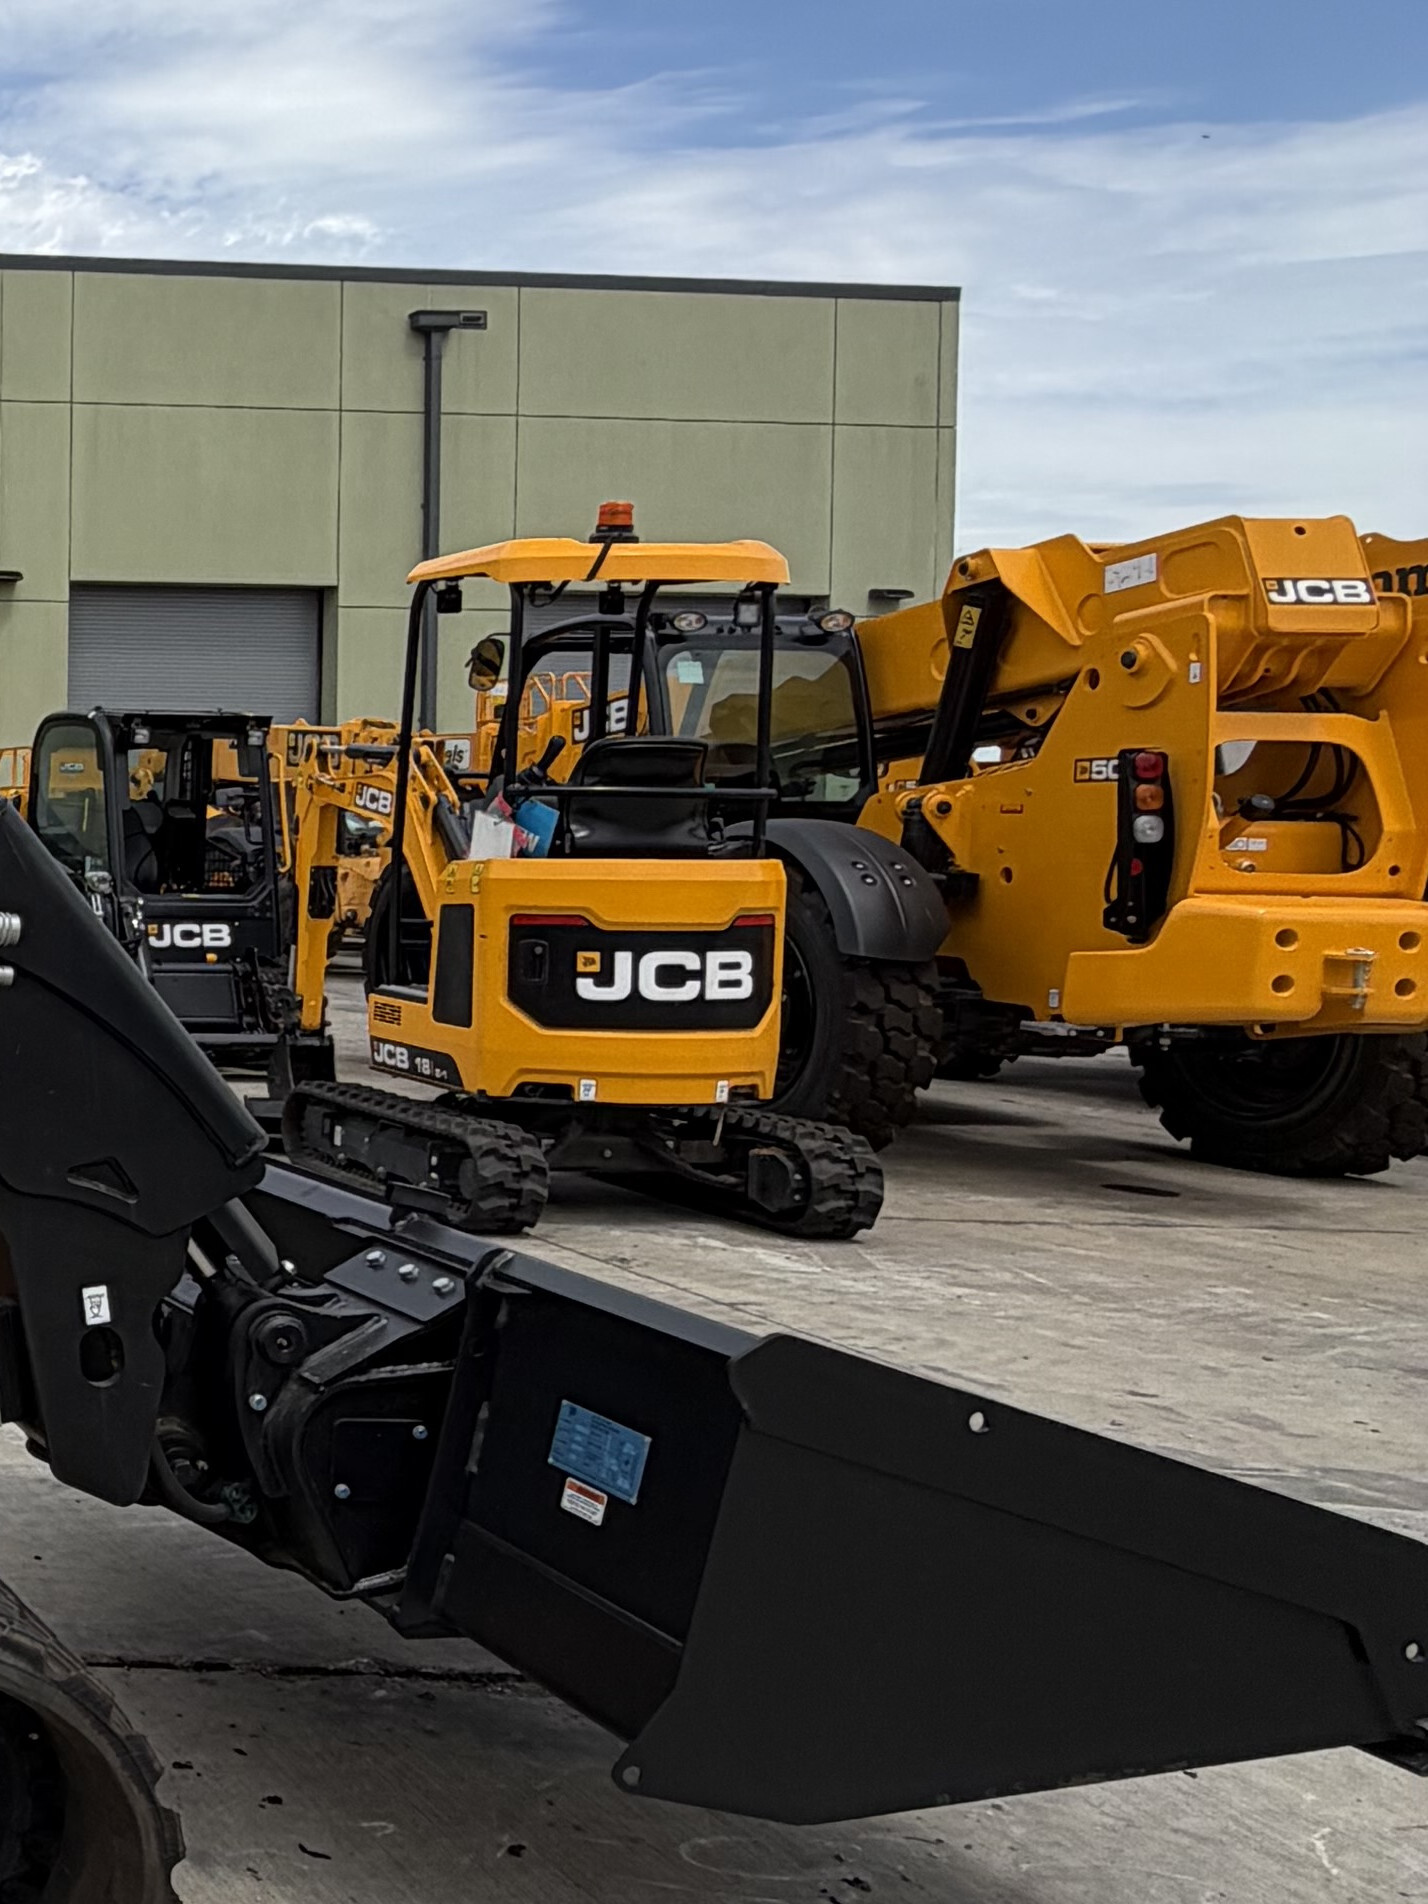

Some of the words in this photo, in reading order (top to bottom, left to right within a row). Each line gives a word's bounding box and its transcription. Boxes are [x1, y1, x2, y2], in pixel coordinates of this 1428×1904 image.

[1268, 580, 1371, 603] JCB
[574, 698, 629, 741] JB
[355, 785, 392, 814] JCB
[148, 924, 231, 947] JCB
[576, 950, 753, 1001] JCB
[374, 1041, 409, 1069] JCB
